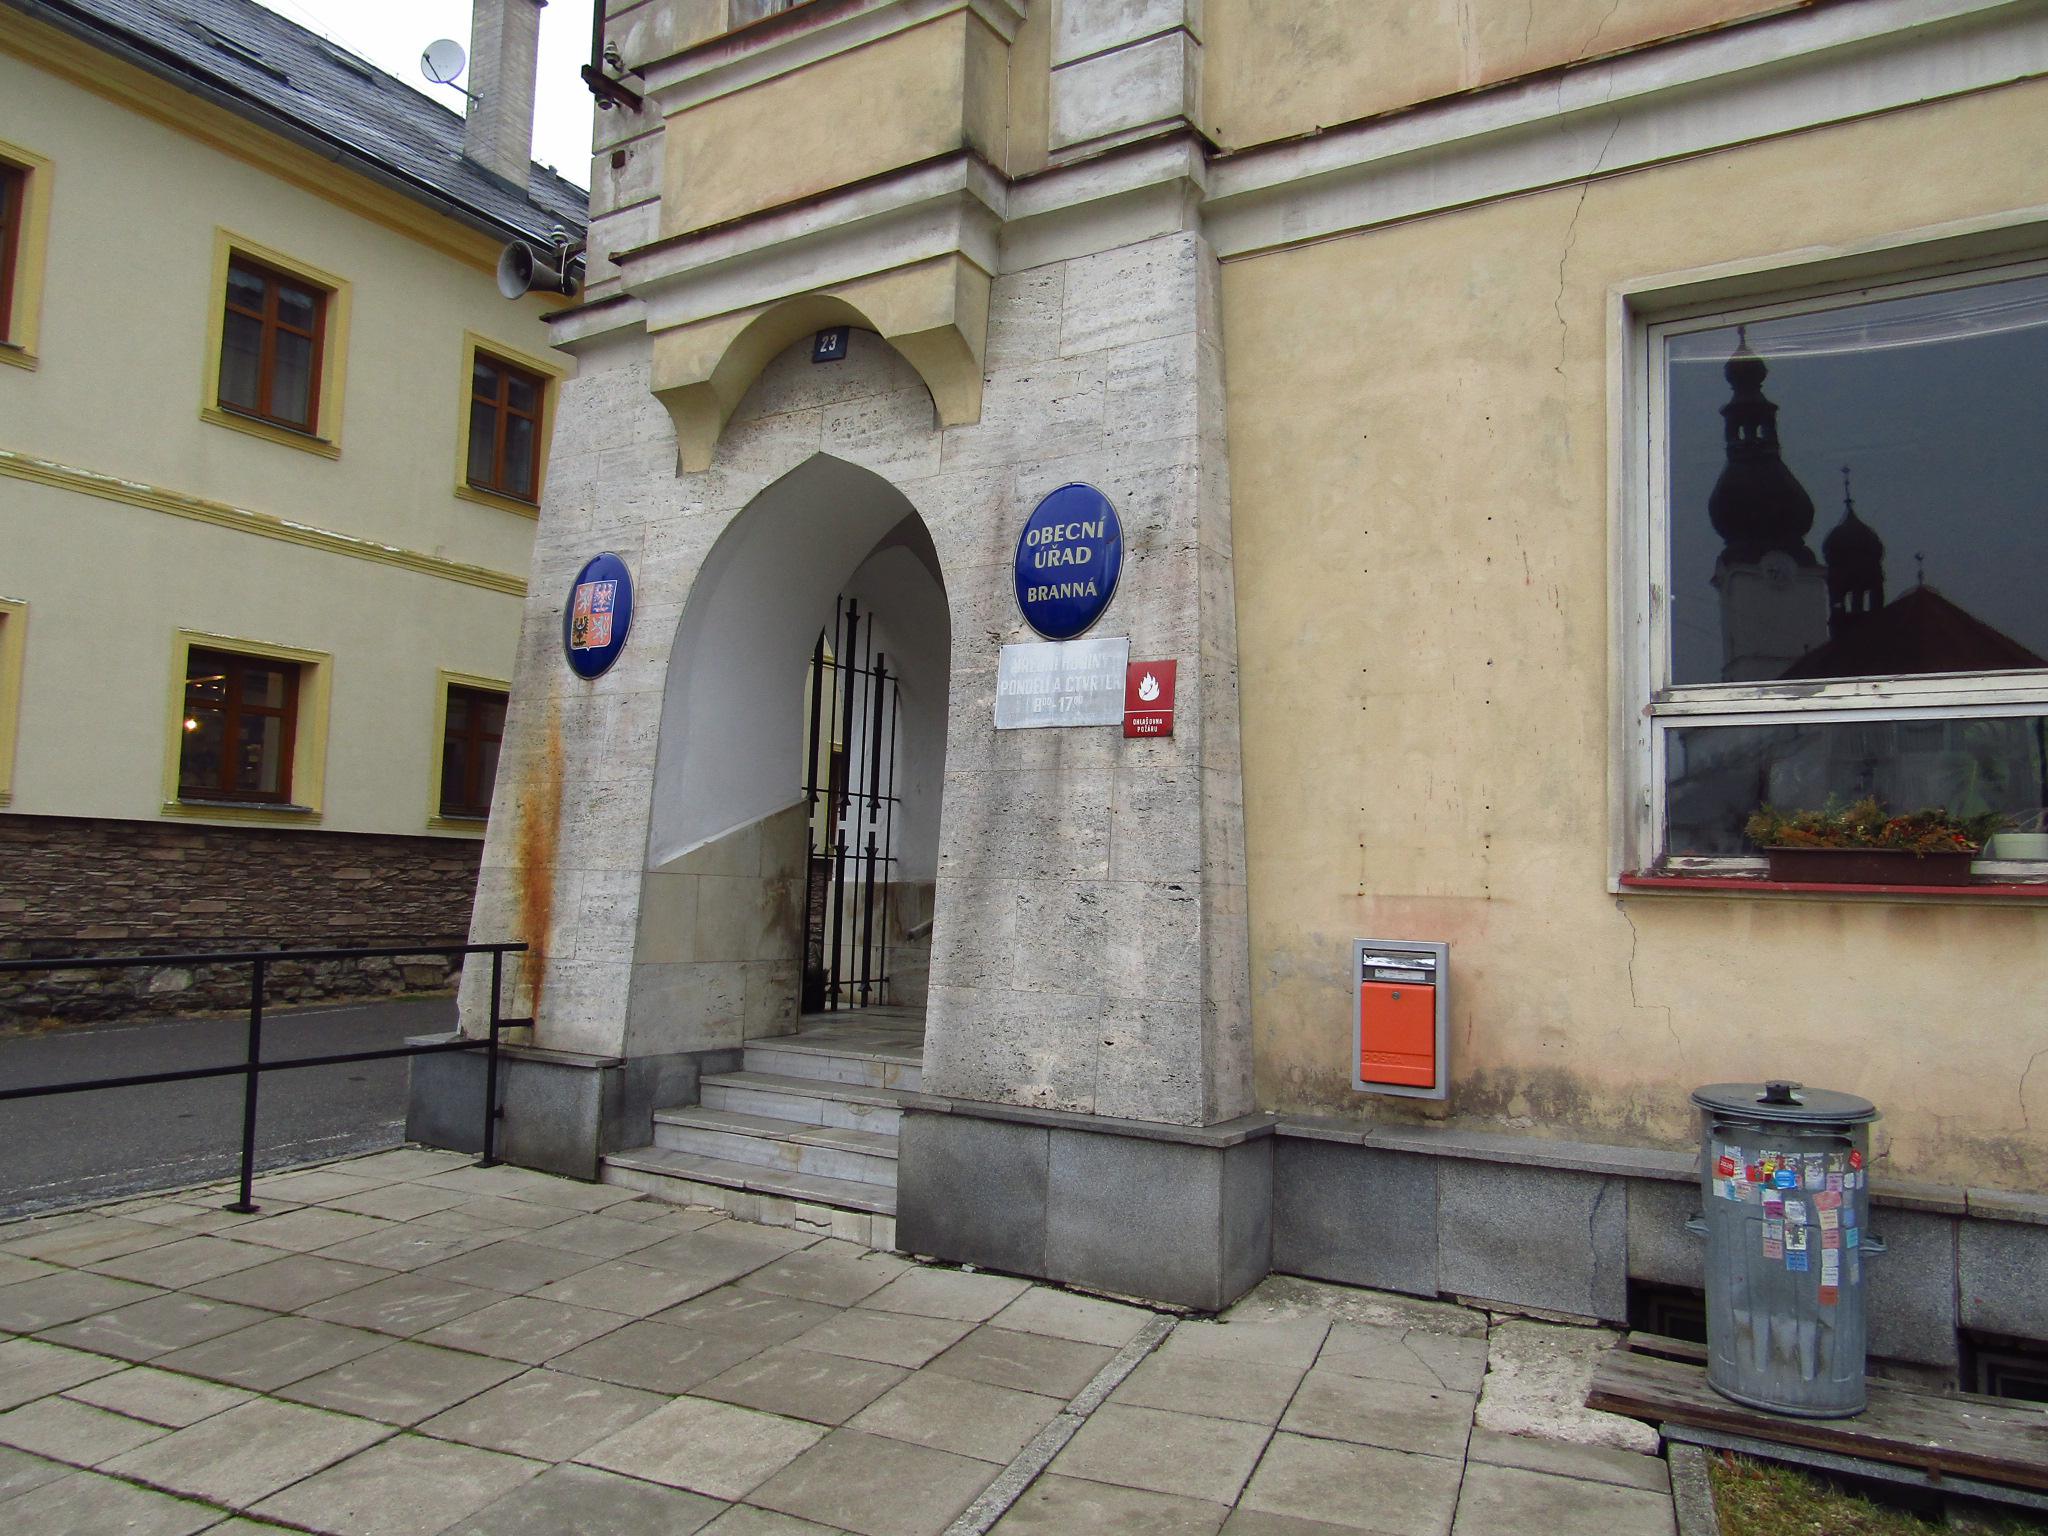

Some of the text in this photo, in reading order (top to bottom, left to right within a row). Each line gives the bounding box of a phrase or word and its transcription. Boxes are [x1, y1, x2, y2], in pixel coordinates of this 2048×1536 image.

[820, 334, 837, 353] 23
[1026, 516, 1106, 547] OBECNÍ
[1034, 543, 1092, 569] ÚŘAD
[1027, 577, 1098, 603] BRANNÁ
